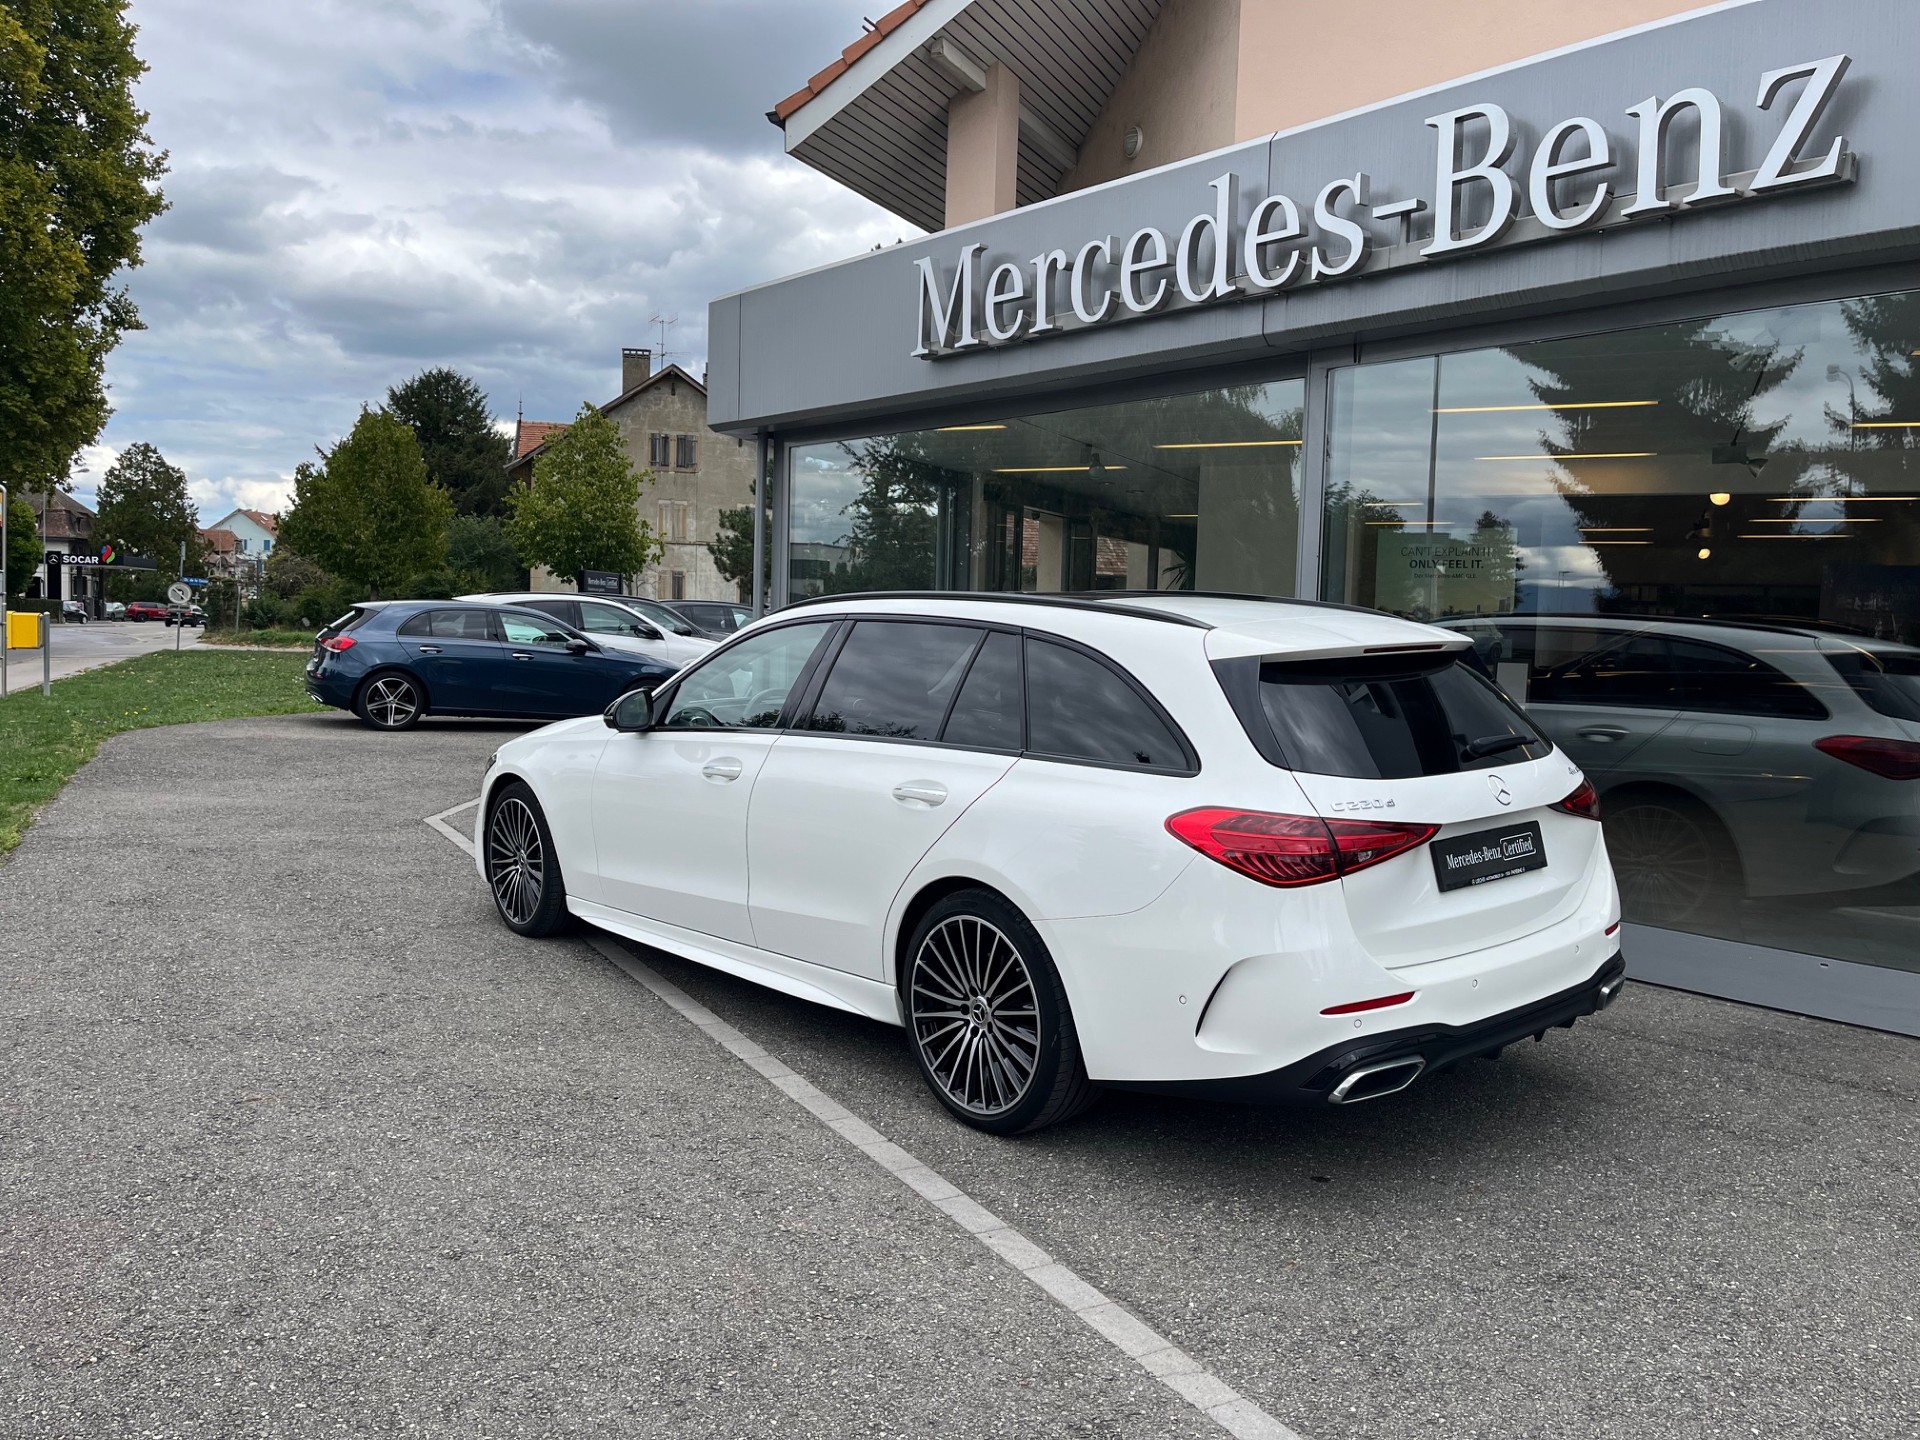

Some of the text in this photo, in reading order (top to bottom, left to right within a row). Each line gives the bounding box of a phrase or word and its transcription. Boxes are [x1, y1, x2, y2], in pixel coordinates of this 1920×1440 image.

[911, 53, 1853, 359] Mercedes-Benz
[1434, 546, 1480, 557] EXPLAIN
[62, 555, 99, 564] SOCAR
[1409, 559, 1439, 569] ONLY
[1441, 559, 1469, 569] FEEL
[1445, 836, 1534, 870] Mercedes-Benz Certified
